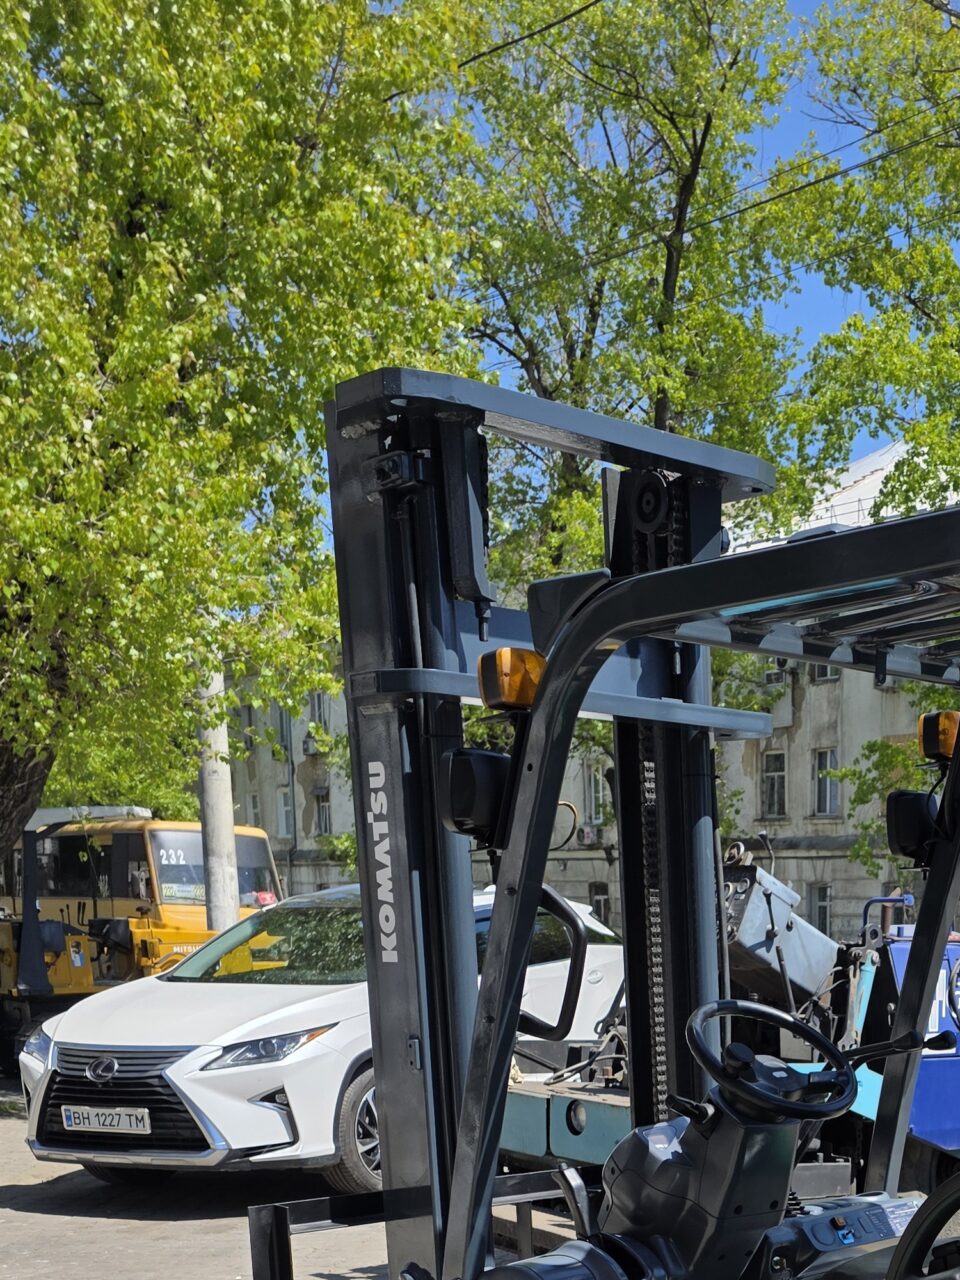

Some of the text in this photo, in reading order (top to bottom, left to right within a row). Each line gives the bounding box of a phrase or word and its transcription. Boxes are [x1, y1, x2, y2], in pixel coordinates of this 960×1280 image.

[160, 849, 186, 865] 232
[367, 761, 398, 963] KOMATSU
[73, 1111, 145, 1129] BH 1227 TM
